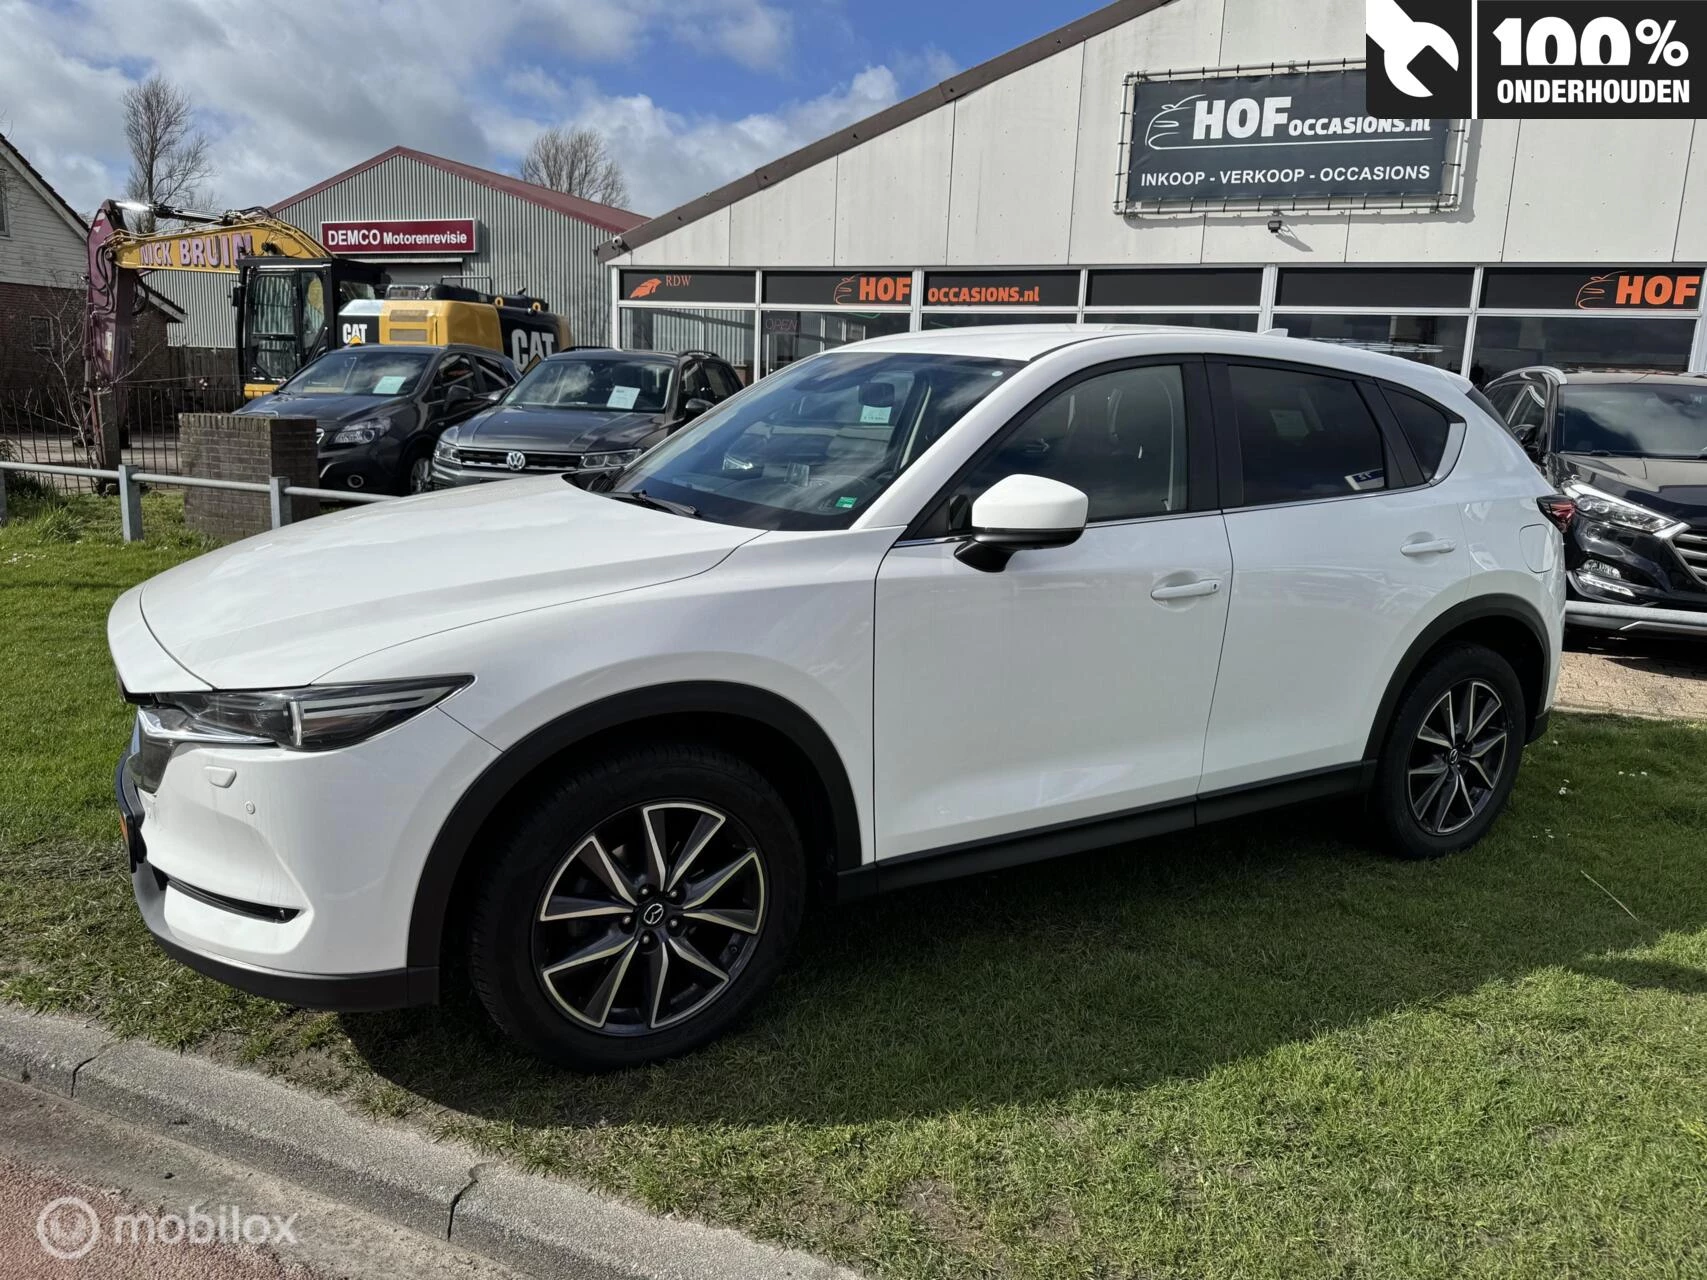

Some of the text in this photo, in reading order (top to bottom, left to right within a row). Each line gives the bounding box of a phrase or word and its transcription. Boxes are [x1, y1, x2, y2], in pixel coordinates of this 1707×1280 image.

[1140, 171, 1206, 187] INKOOP
[1219, 168, 1305, 184] VERKOOP
[1320, 165, 1431, 182] OCCASIONS
[328, 229, 467, 246] DEMCO Motorenrevisie
[140, 232, 254, 268] NICK BRUIN
[665, 275, 692, 287] RDW
[859, 277, 1040, 303] HOF OCCASIONS.nl
[1615, 275, 1701, 305] HOF
[342, 323, 368, 344] CAT
[765, 318, 799, 331] OPEN
[511, 328, 554, 373] CAT
